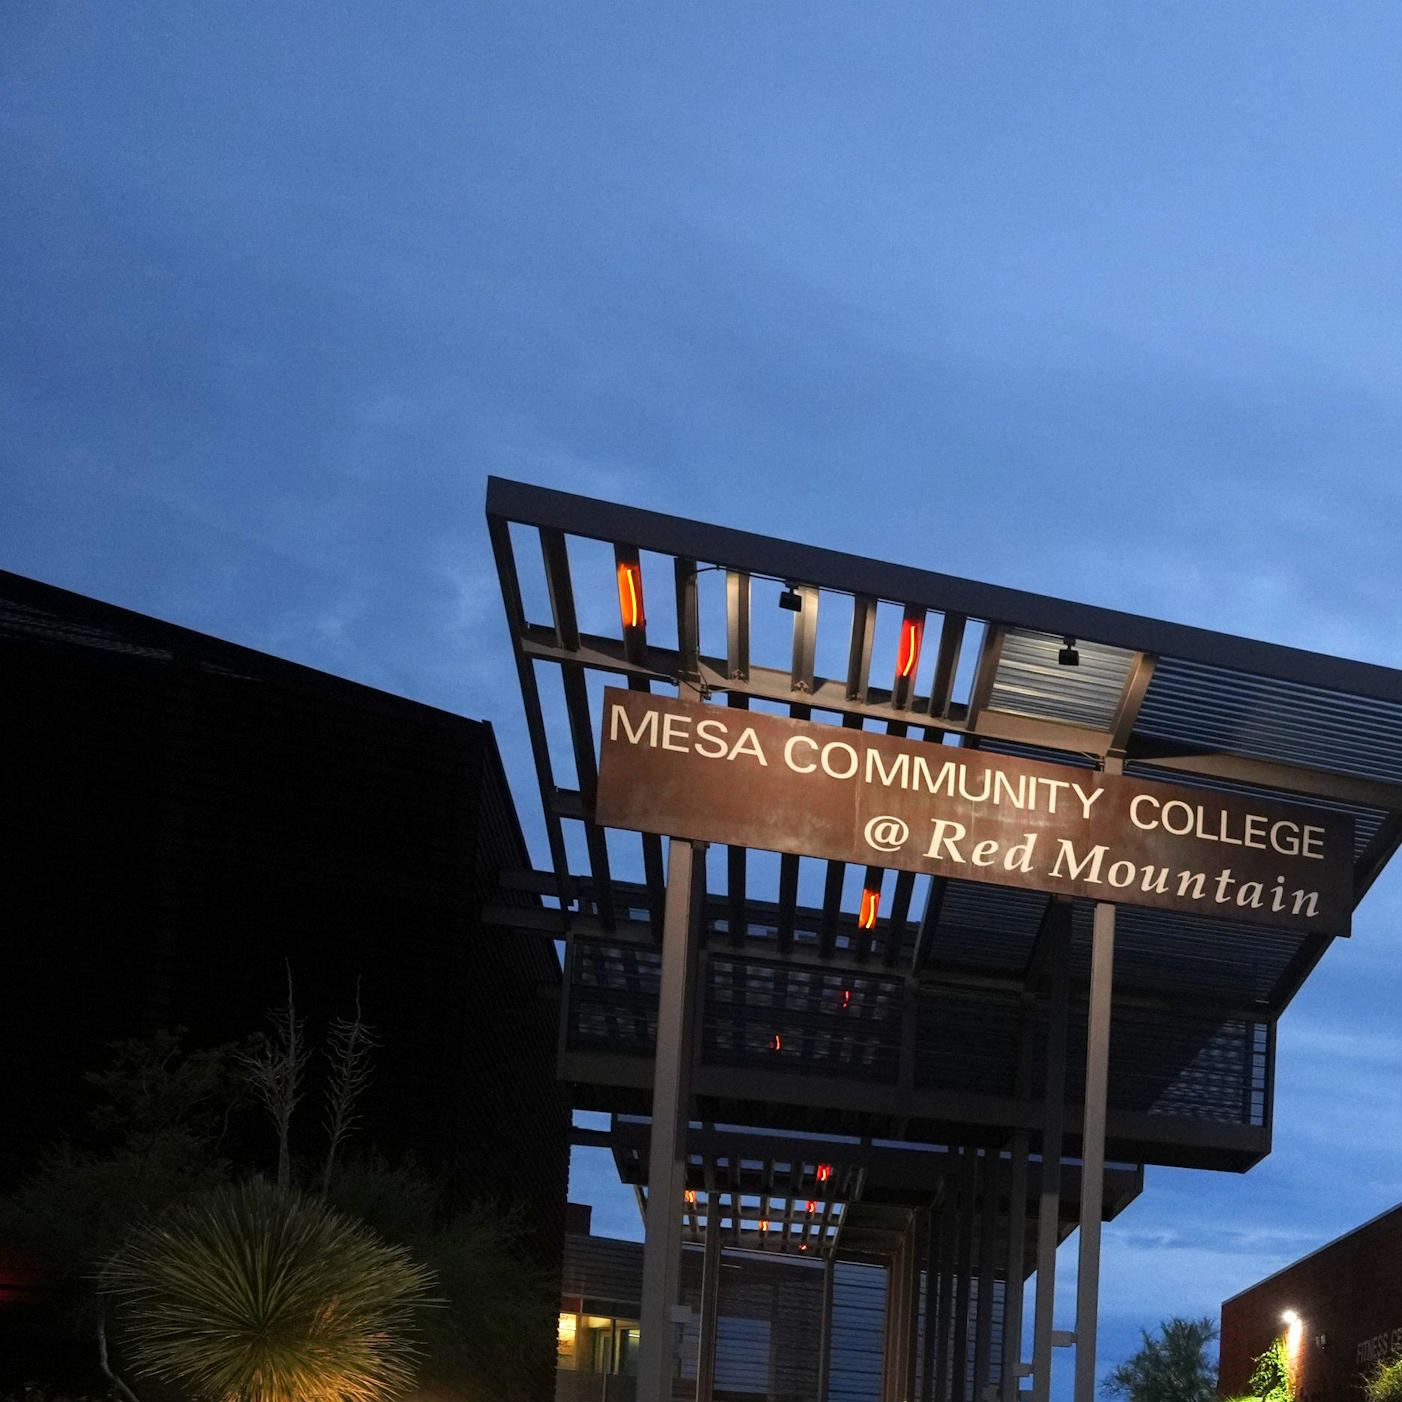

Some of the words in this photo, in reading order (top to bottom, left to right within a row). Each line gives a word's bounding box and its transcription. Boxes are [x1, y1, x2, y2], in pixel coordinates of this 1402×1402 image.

[610, 704, 768, 767] MESA
[783, 734, 1106, 820] COMMUNITY
[1129, 793, 1325, 860] COLLEGE
[863, 815, 910, 853] @
[922, 816, 1038, 873] Red
[1048, 837, 1321, 917] Mountain
